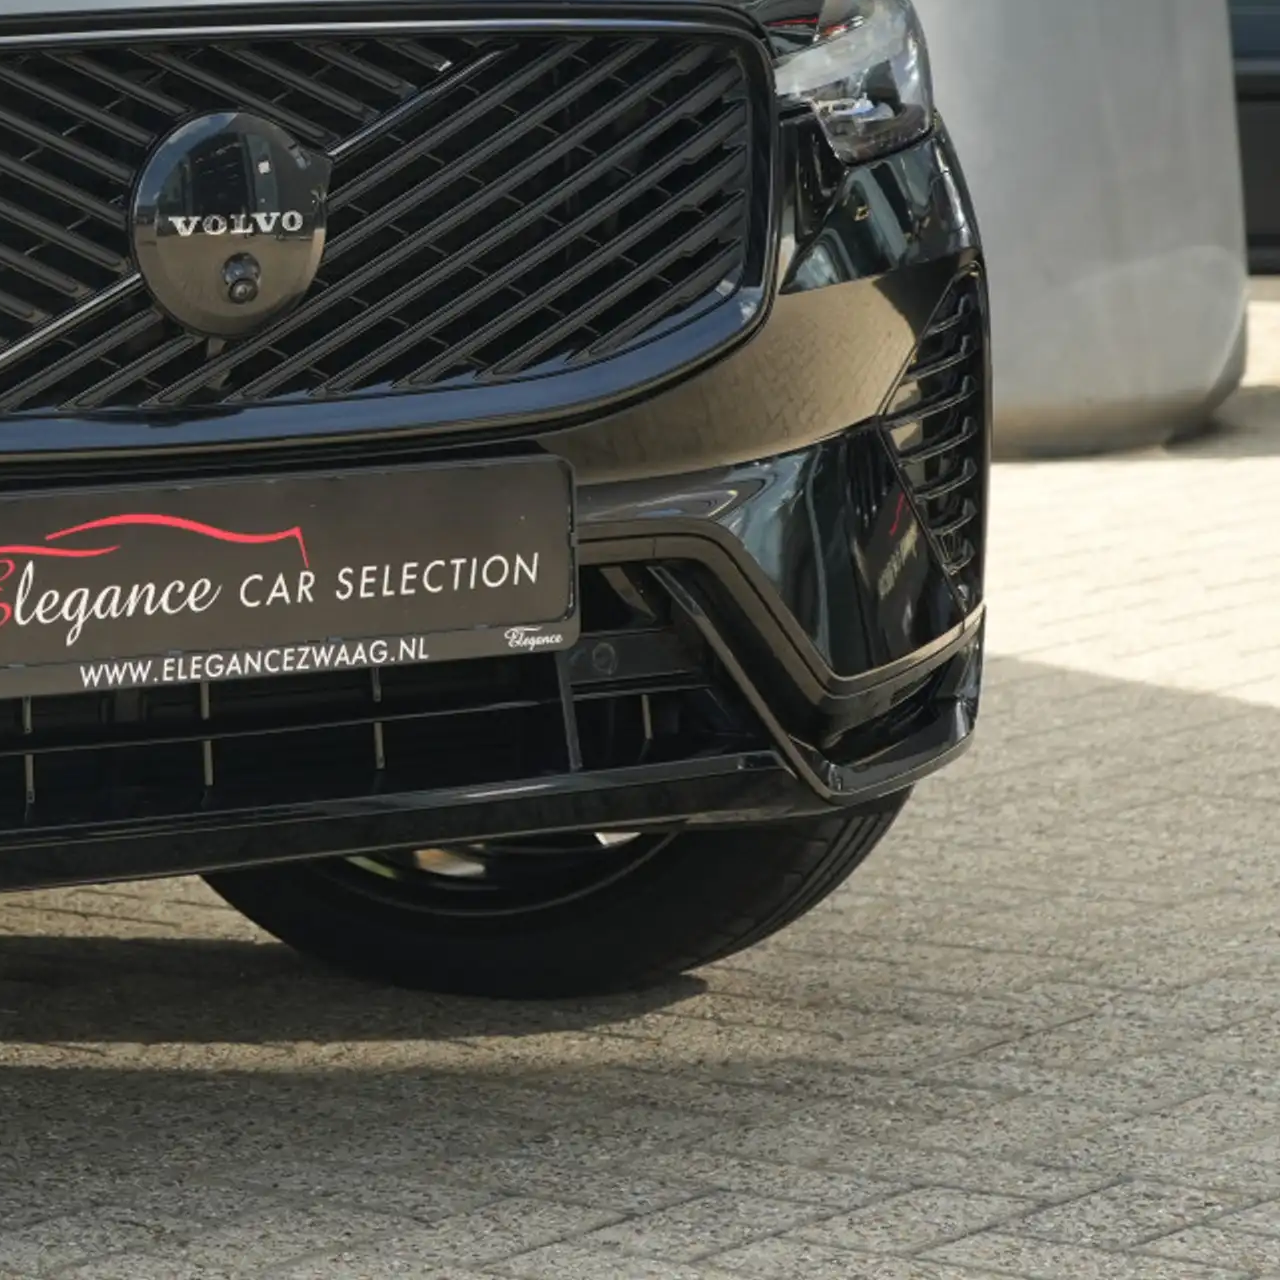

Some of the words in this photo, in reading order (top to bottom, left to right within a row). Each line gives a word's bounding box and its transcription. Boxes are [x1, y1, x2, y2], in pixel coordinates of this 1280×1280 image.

[168, 210, 304, 237] VOLVO
[239, 571, 317, 608] CAR
[335, 552, 540, 601] SELECTION
[504, 625, 563, 652] Elegance
[79, 636, 430, 689] WWW.ELEGANCEZWAAG.NL
